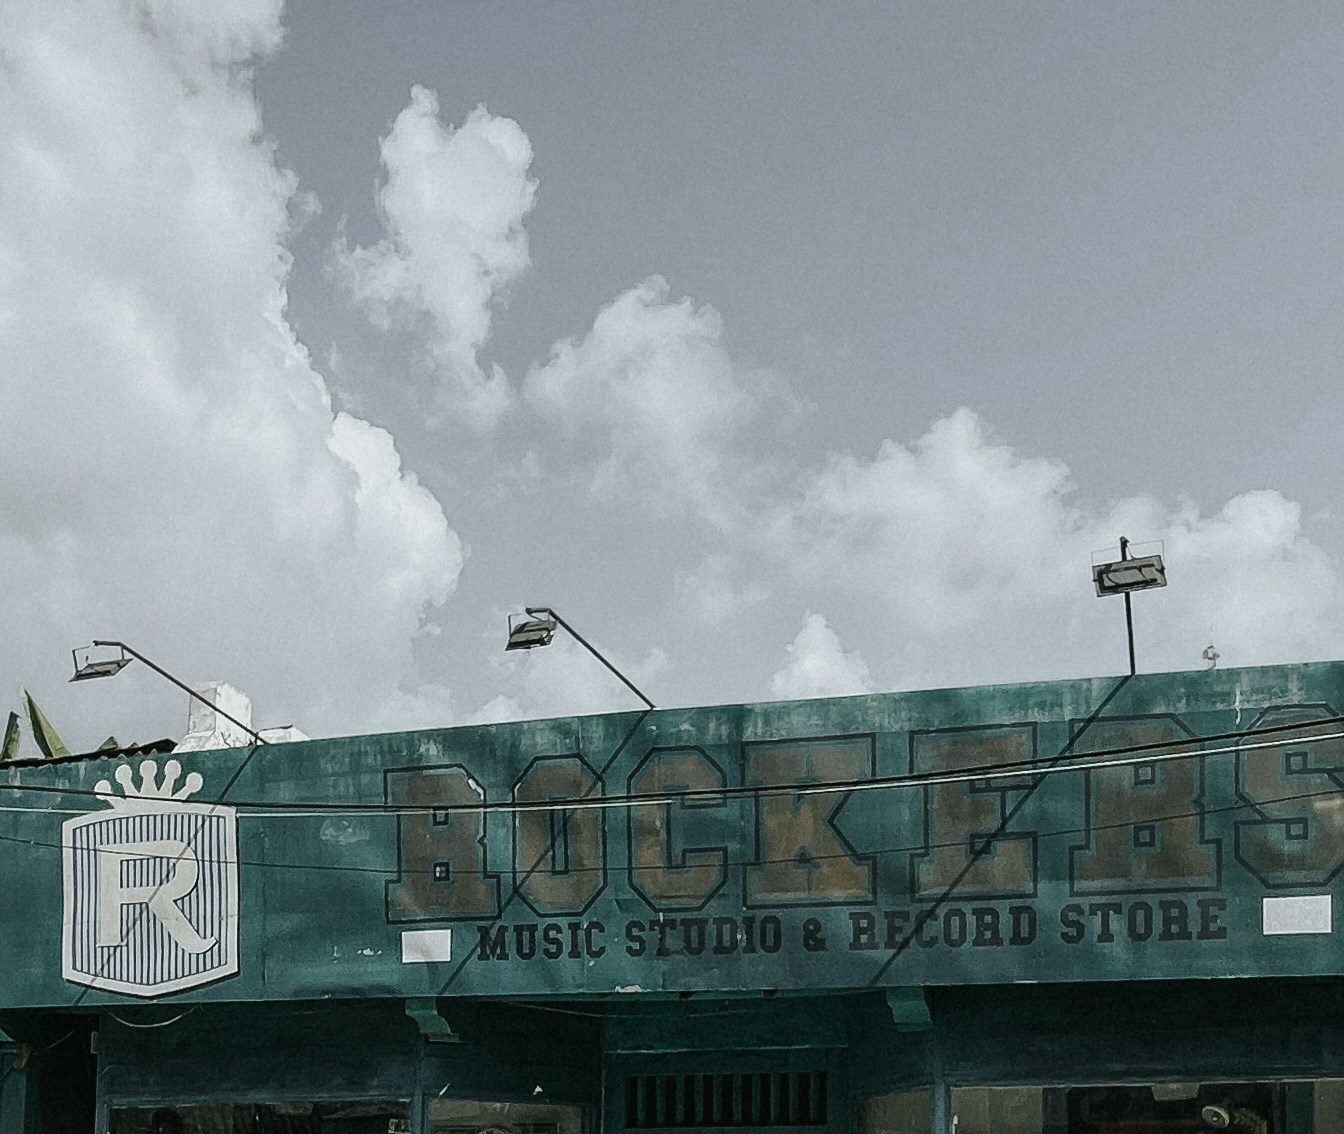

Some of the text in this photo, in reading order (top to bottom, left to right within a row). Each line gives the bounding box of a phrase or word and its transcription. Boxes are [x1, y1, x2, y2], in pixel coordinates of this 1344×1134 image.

[95, 841, 217, 954] R
[476, 900, 1228, 961] MUSIC STUDIO & RECORD STORE
